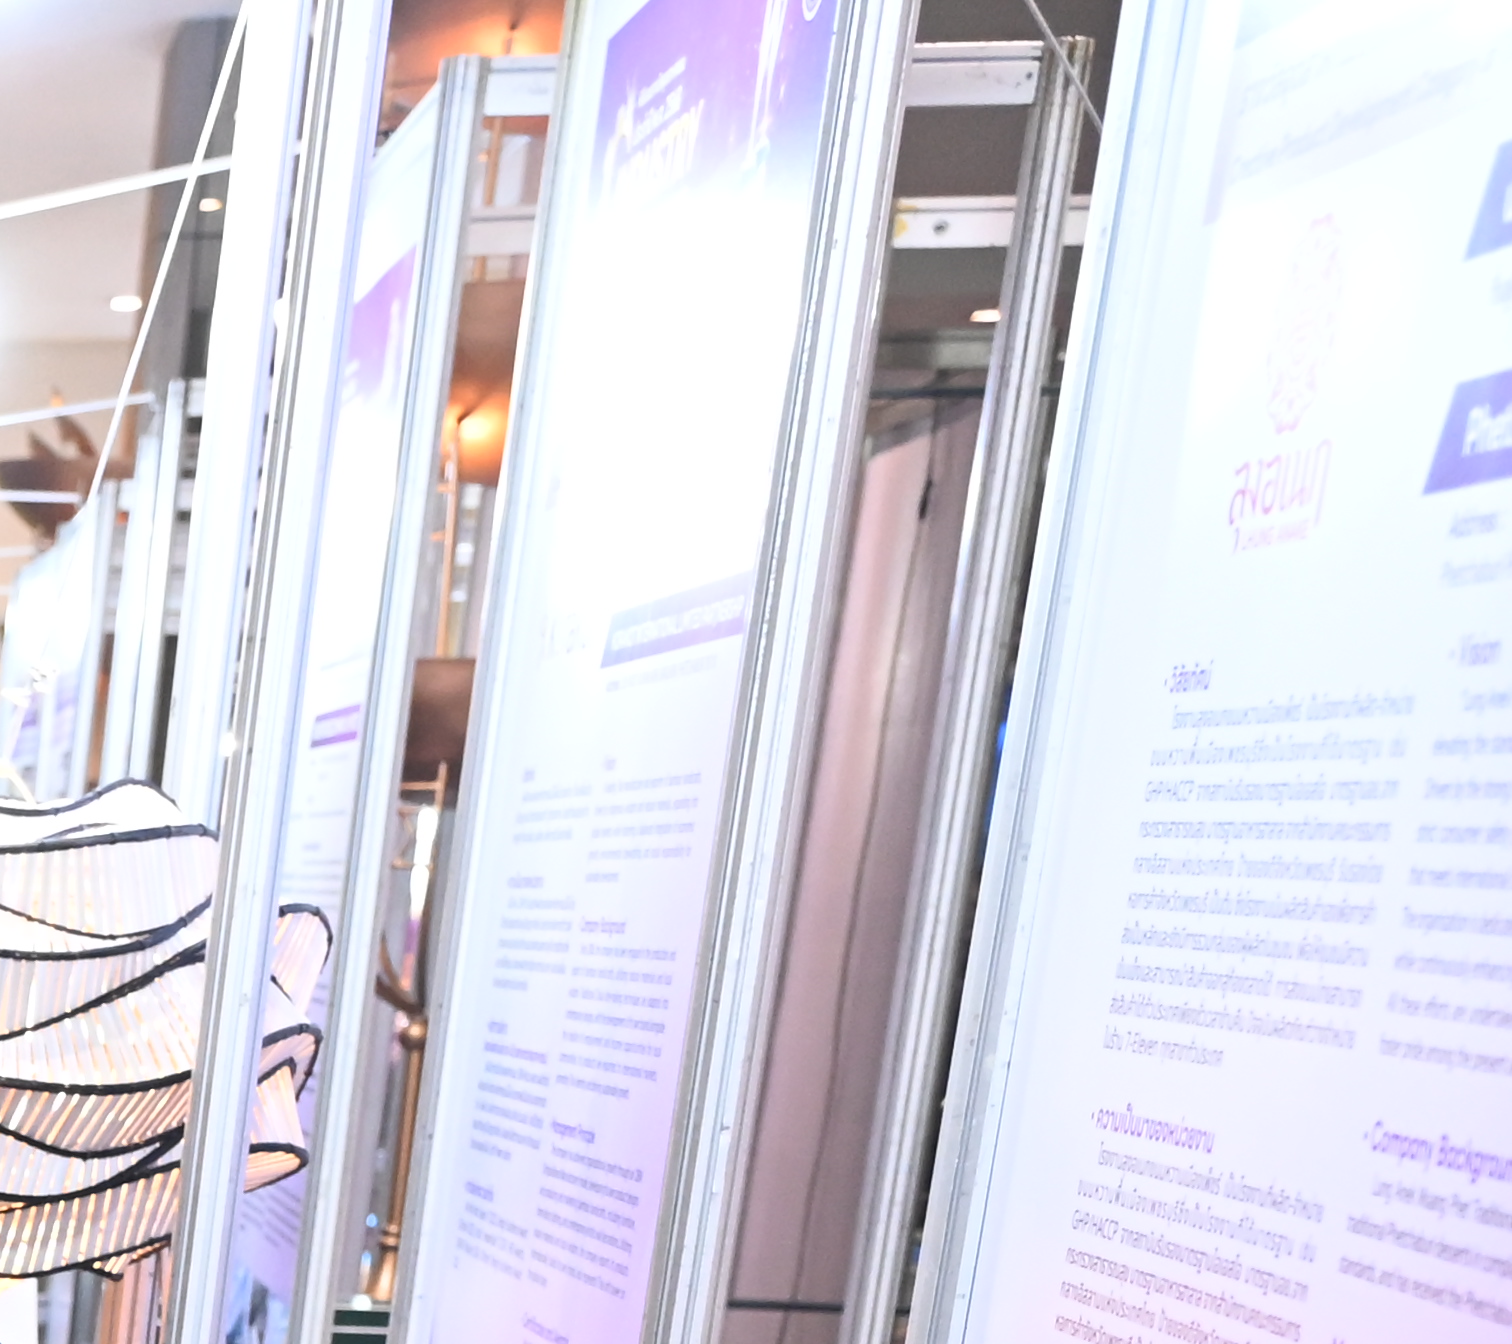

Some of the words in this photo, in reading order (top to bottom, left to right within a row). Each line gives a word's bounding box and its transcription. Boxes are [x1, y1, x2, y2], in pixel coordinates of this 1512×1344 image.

[1124, 1030, 1158, 1056] 7-Eleven
[1095, 1103, 1214, 1153] ความเป็นมาของหน่วยงาน
[1370, 1119, 1434, 1160] Company
